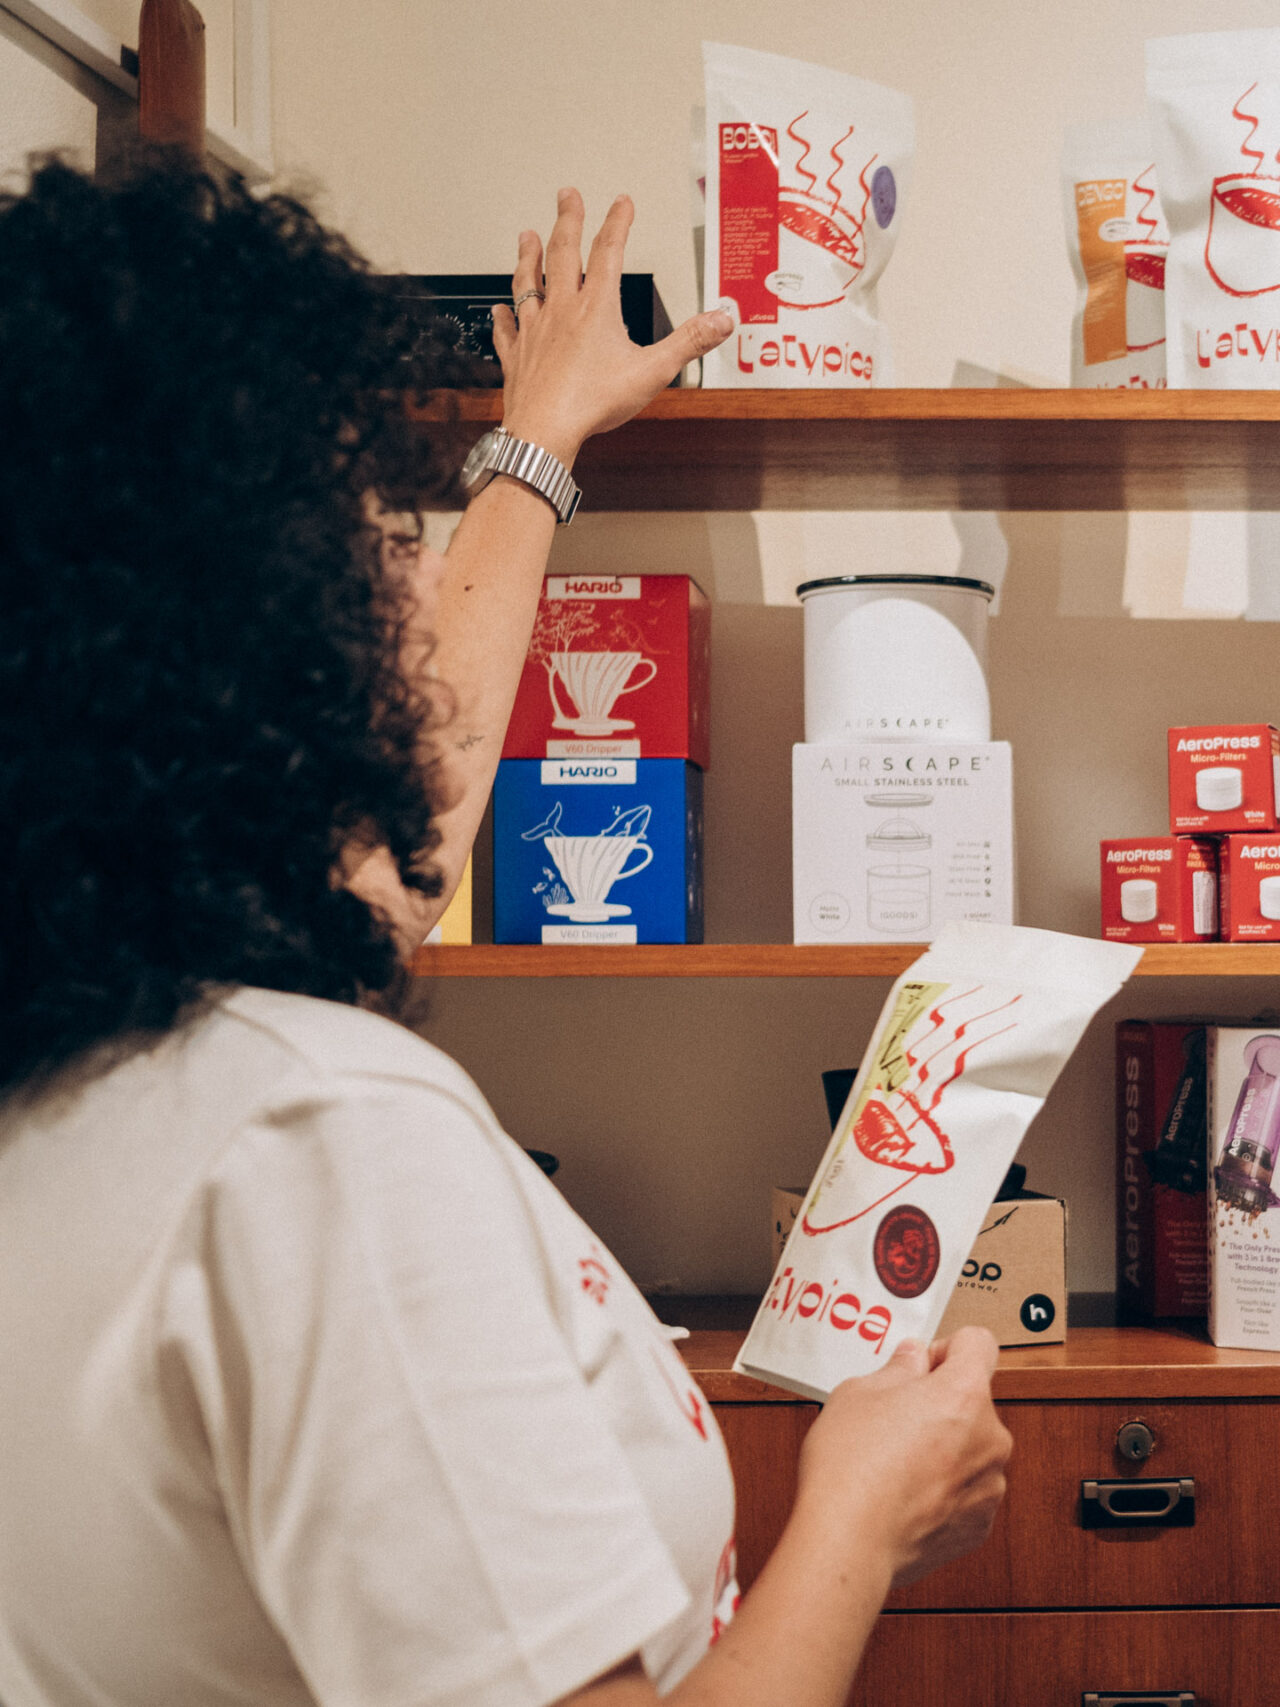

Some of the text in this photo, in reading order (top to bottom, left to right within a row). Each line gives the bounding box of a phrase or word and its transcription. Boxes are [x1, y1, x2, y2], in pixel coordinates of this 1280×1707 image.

[565, 582, 623, 594] HARIO
[564, 743, 622, 756] V60 Dripper
[1176, 736, 1261, 752] AeroPress
[1190, 752, 1247, 763] Micro-Filters
[560, 766, 617, 778] HARIO
[834, 777, 970, 787] SMALL STAINLESS STEEL
[1106, 849, 1173, 862] AeroPress
[1116, 865, 1161, 874] Micro-Filters
[560, 929, 618, 941] V60 Dripper
[1164, 1077, 1194, 1143] AeroPress
[1228, 1087, 1257, 1157] AeroPress
[1123, 1055, 1141, 1289] AeroPress
[1229, 1242, 1242, 1250] The
[1244, 1243, 1261, 1252] Only
[1235, 1262, 1278, 1274] Technology
[957, 1281, 998, 1293] brewer
